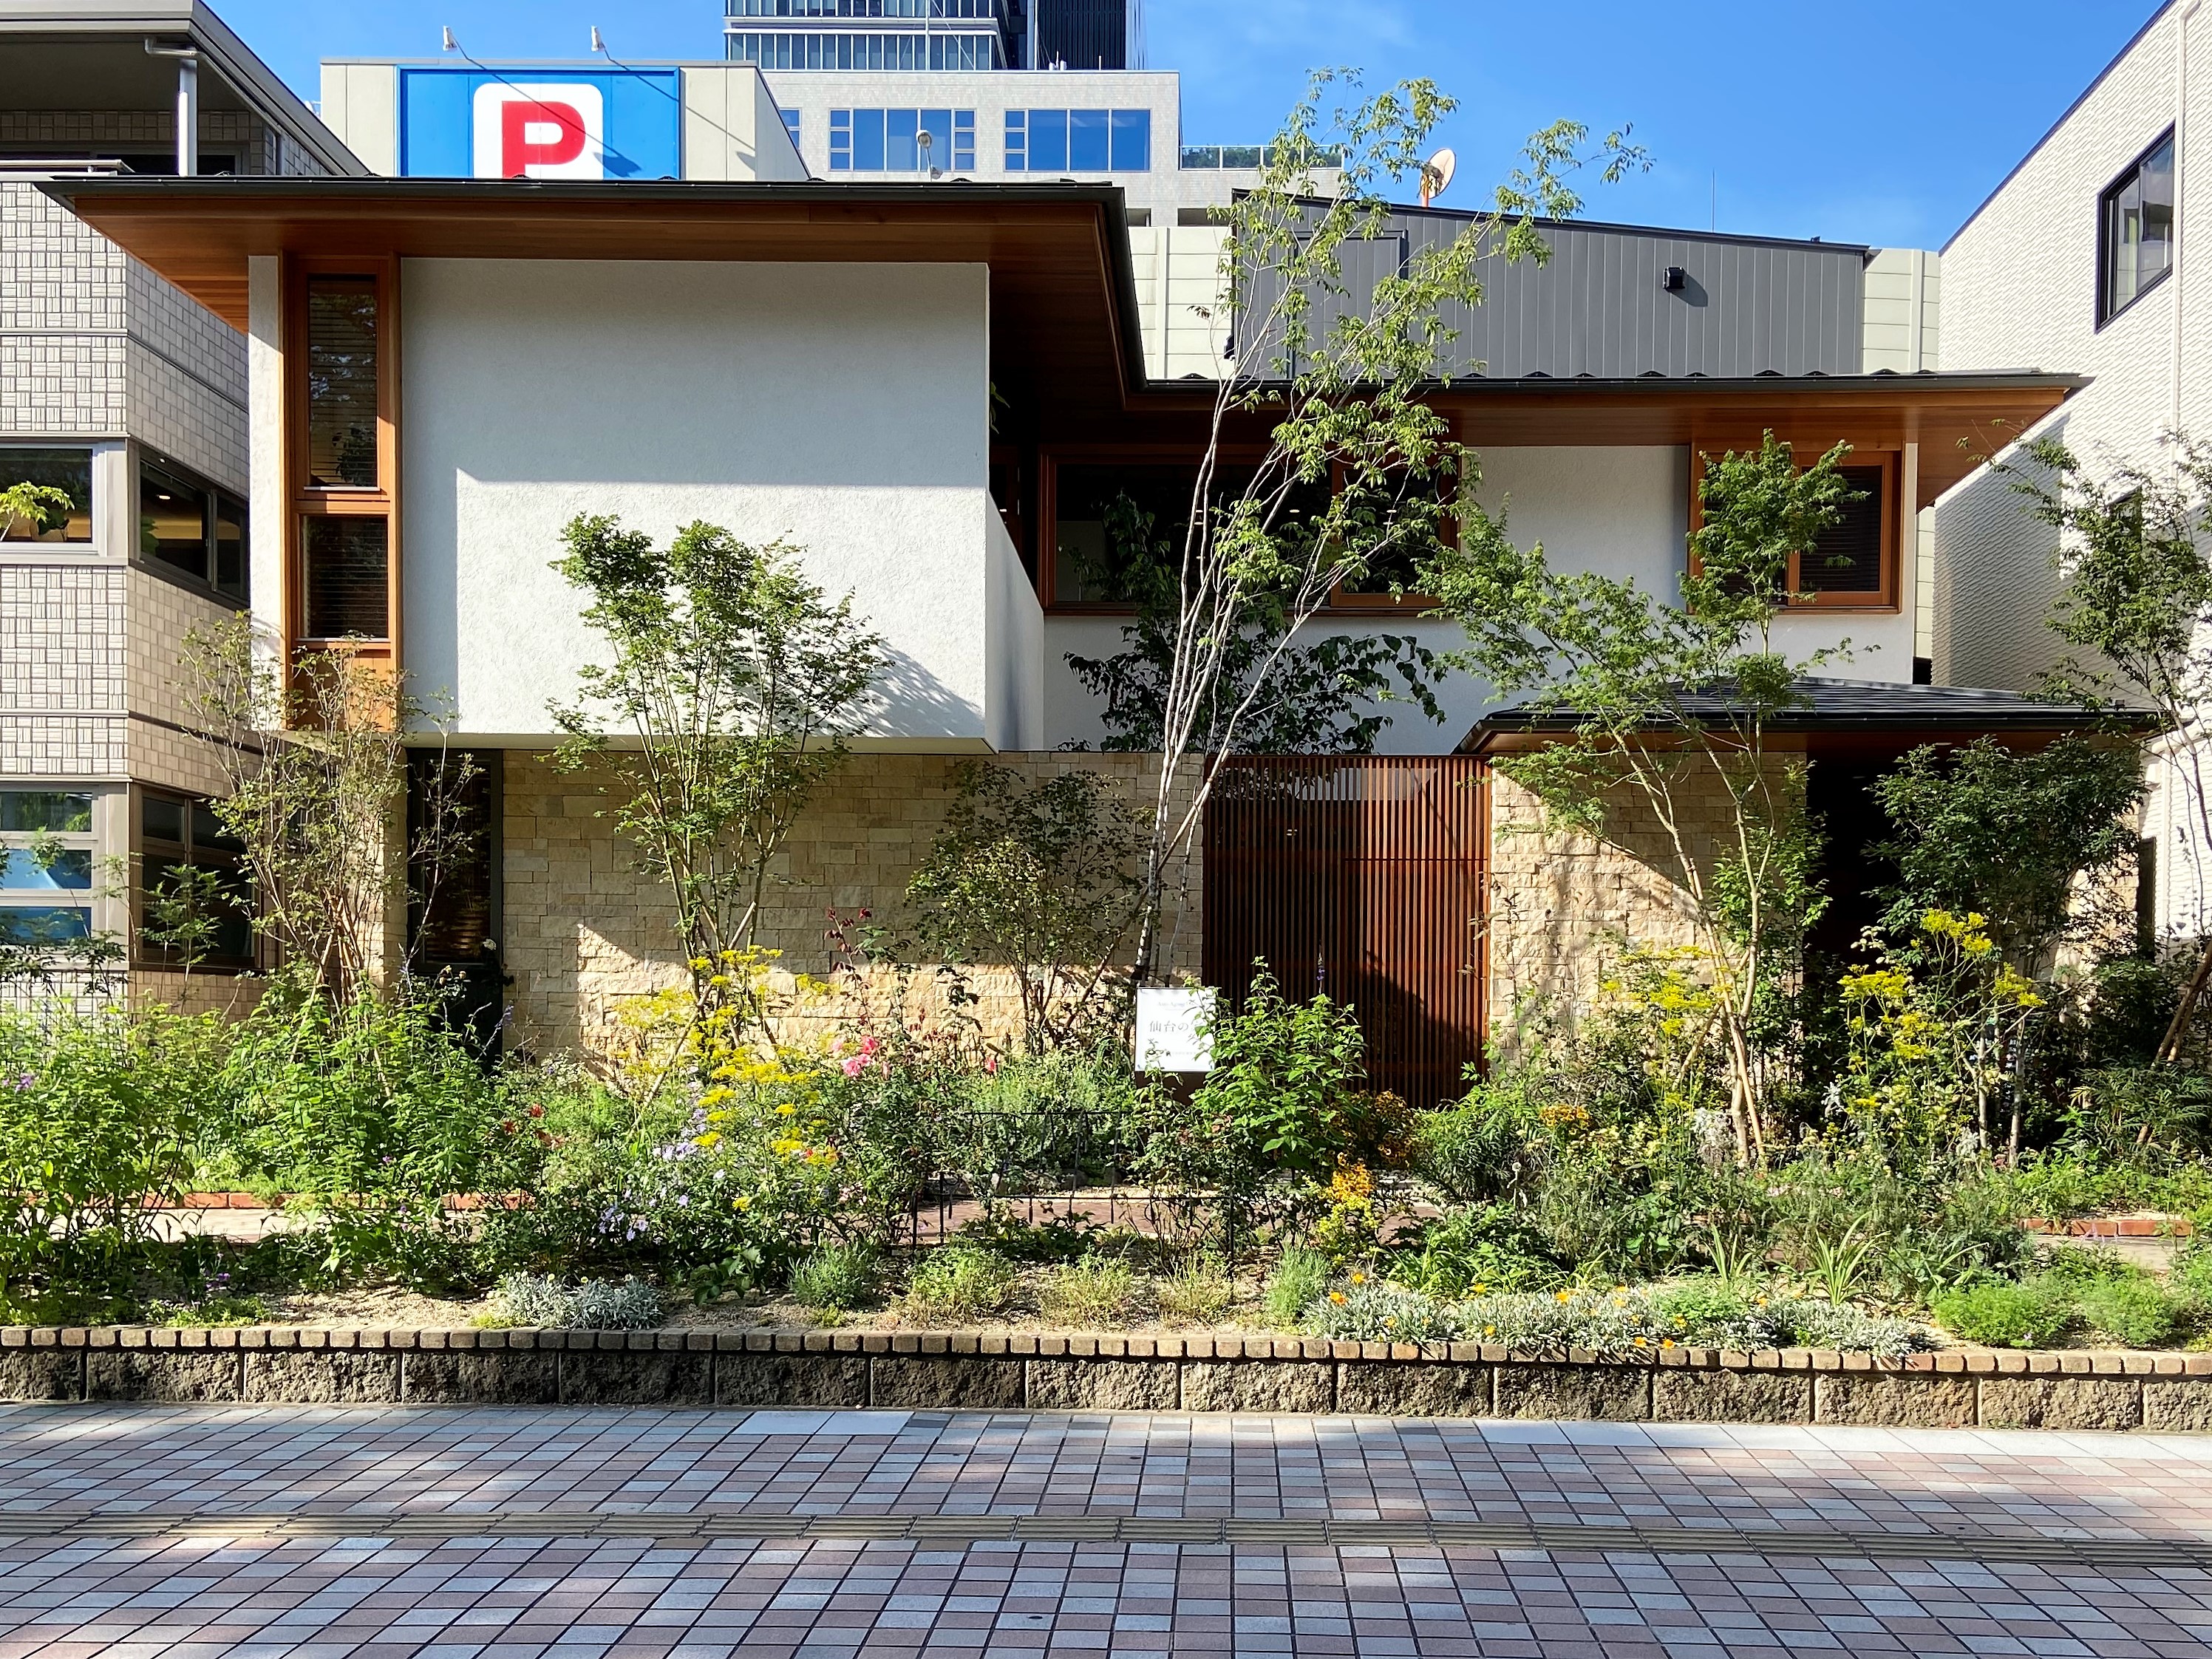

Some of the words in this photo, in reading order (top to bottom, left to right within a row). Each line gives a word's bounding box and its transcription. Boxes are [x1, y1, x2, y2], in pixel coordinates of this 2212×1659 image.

[502, 101, 586, 179] P
[1149, 1020, 1204, 1033] 仙台の
